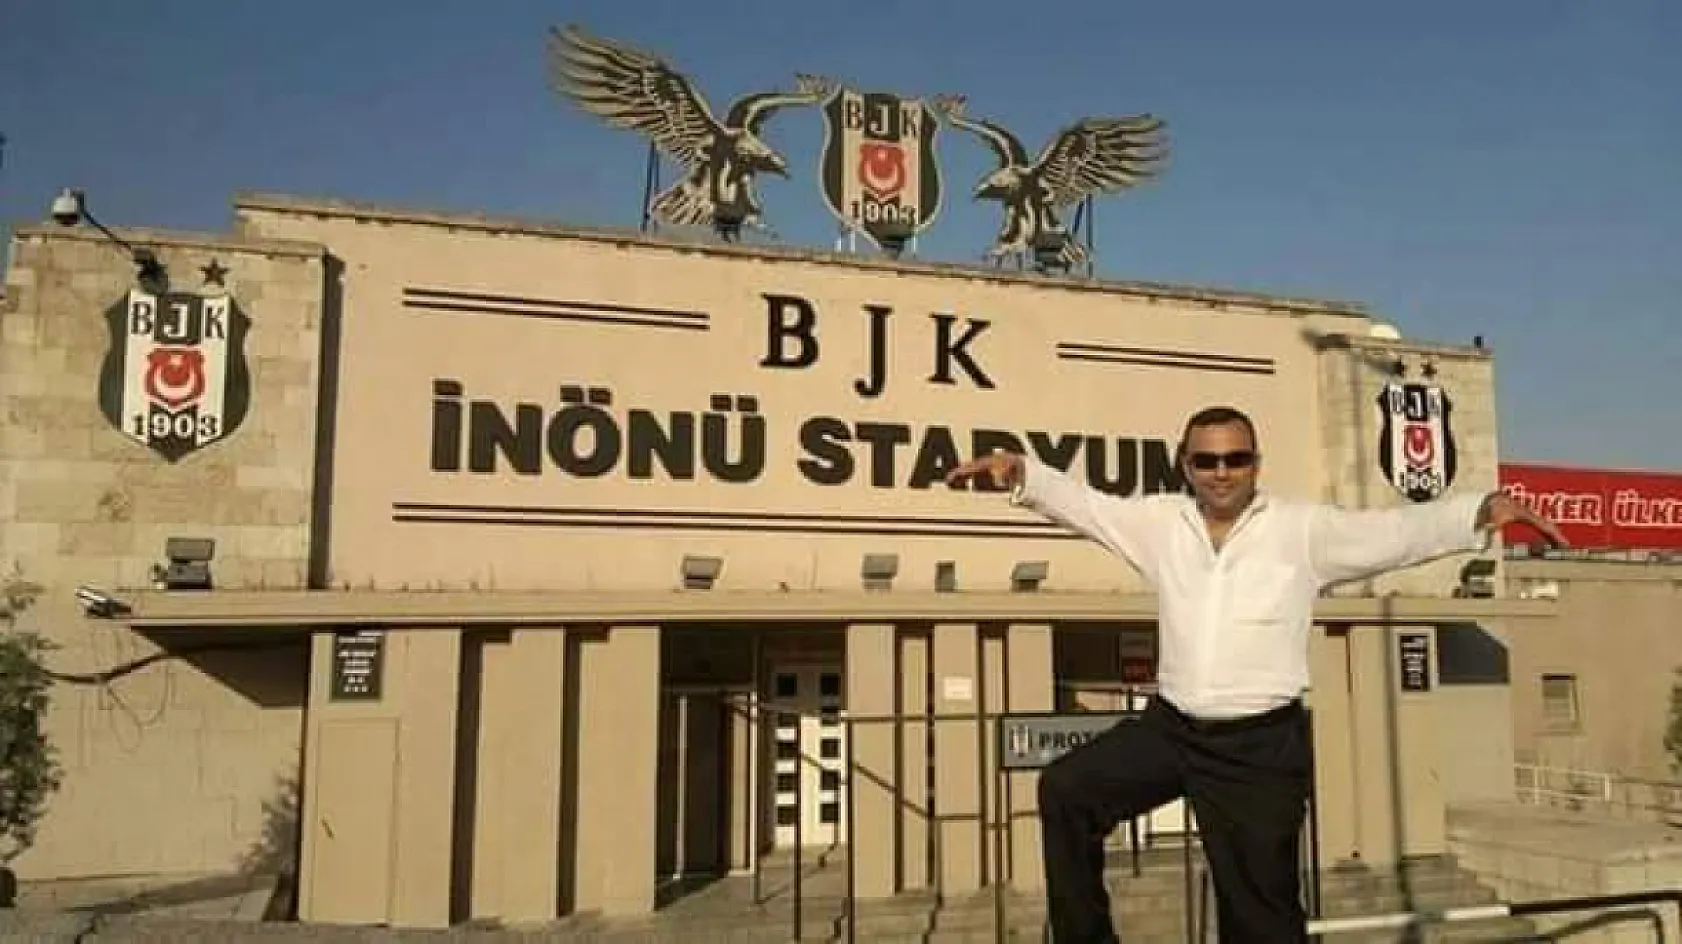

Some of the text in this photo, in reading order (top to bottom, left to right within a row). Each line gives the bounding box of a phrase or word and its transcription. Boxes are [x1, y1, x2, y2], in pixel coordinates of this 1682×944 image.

[847, 100, 917, 137] BJK
[131, 302, 225, 338] BJK
[133, 412, 218, 438] 1903
[431, 379, 766, 484] İNÖNÜ
